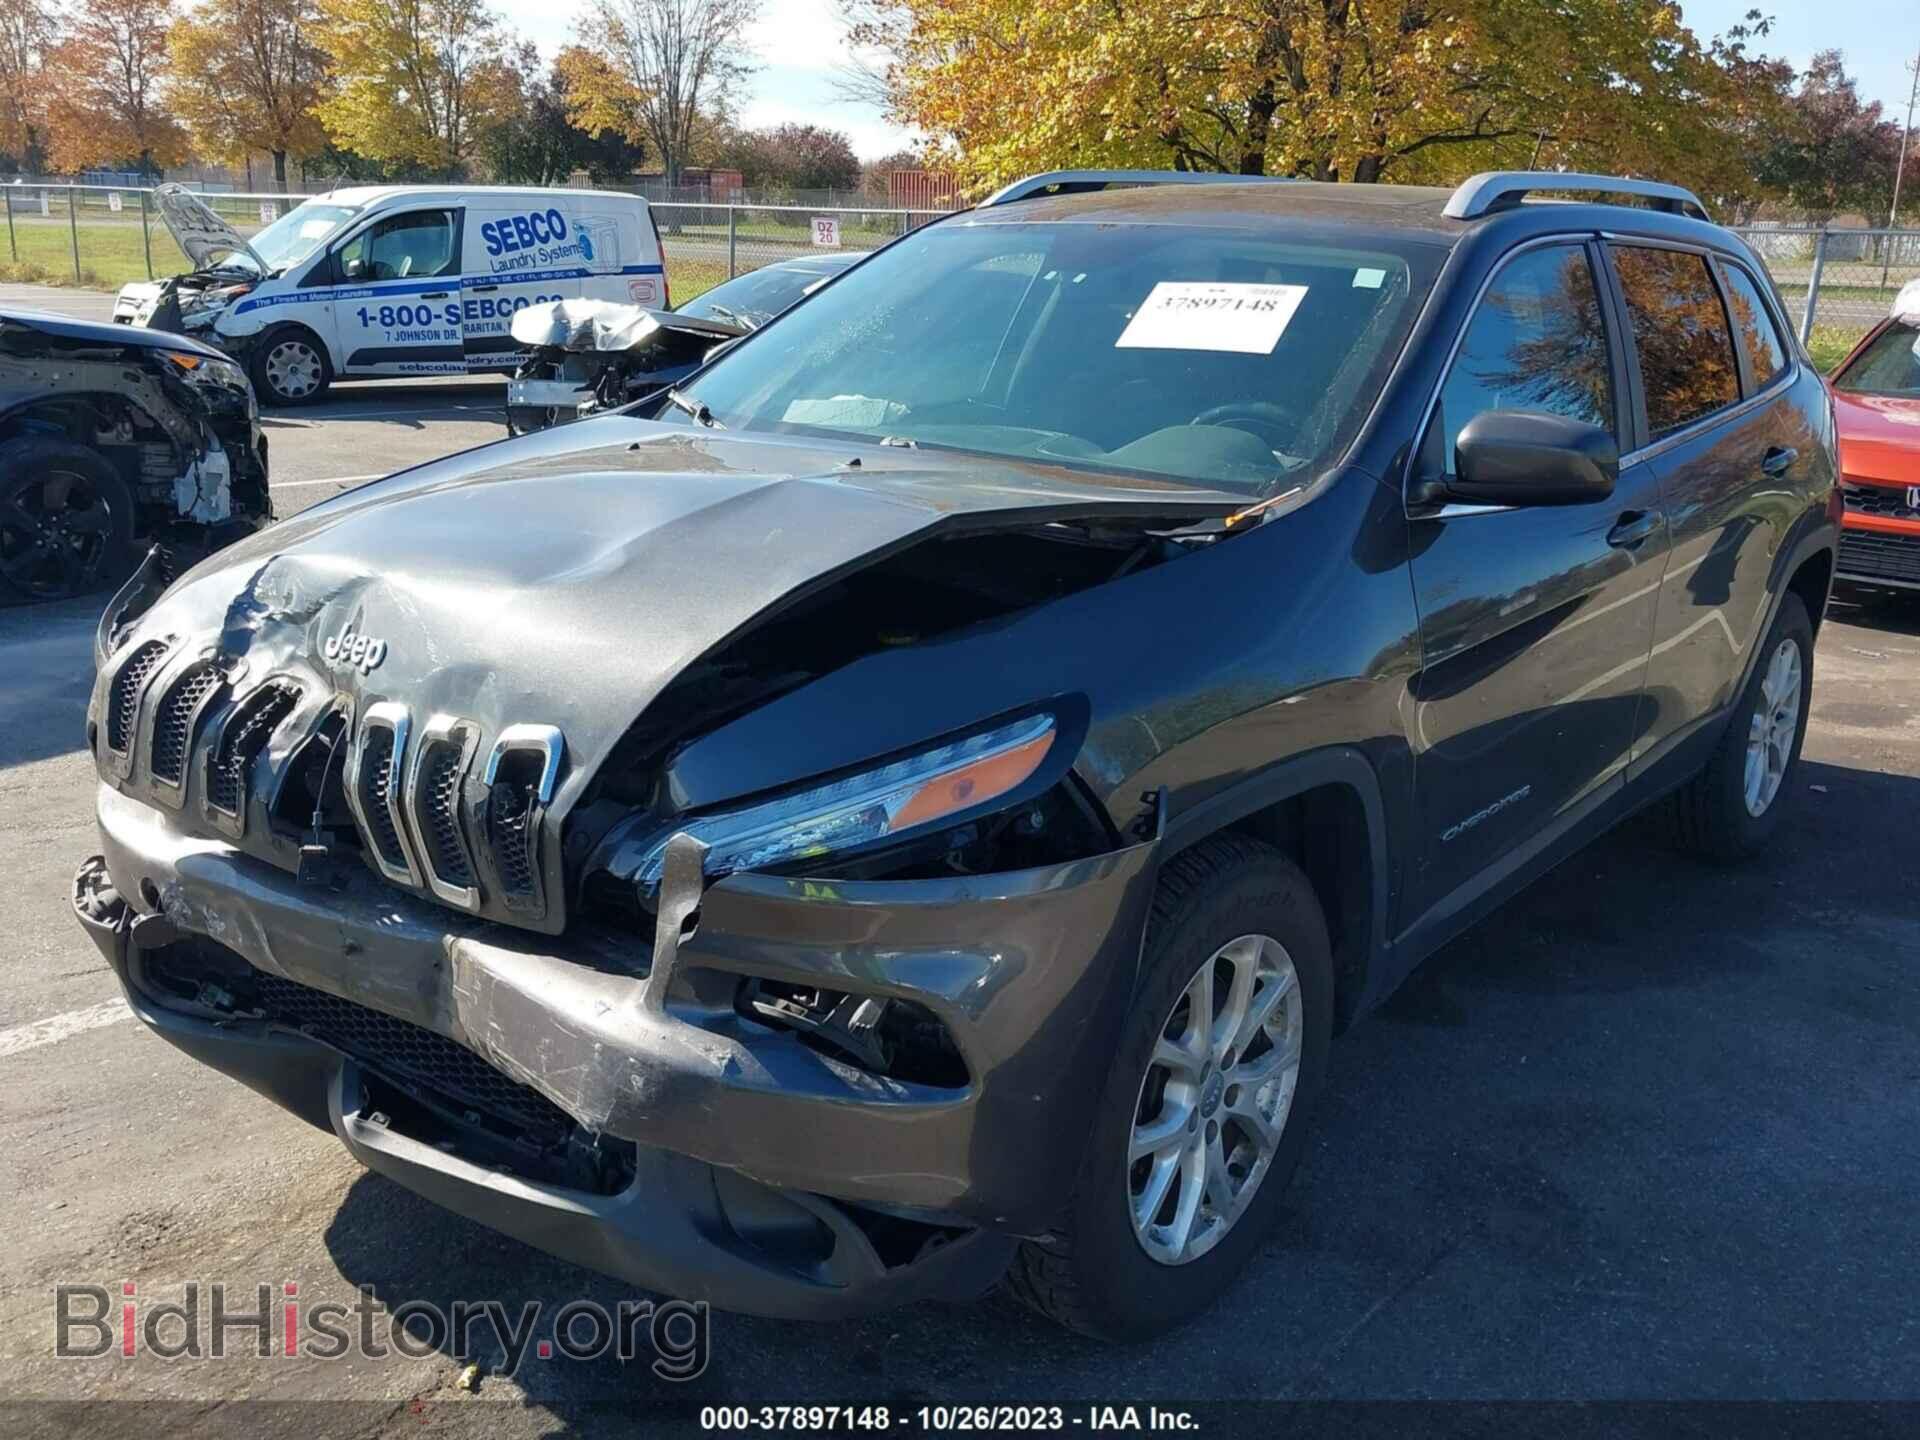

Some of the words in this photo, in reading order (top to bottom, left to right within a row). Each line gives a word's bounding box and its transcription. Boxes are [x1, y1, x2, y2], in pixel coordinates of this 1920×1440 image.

[481, 208, 567, 256] SEBCO
[817, 221, 833, 232] DZ
[819, 233, 833, 243] 20
[490, 252, 536, 273] Laundry
[538, 244, 584, 264] Systems
[1157, 296, 1278, 312] 37897148
[385, 331, 390, 341] 7
[394, 330, 439, 342] JOHNSON
[444, 329, 460, 340] DR.
[464, 321, 506, 334] RARITAN,
[325, 621, 387, 676] Jeep
